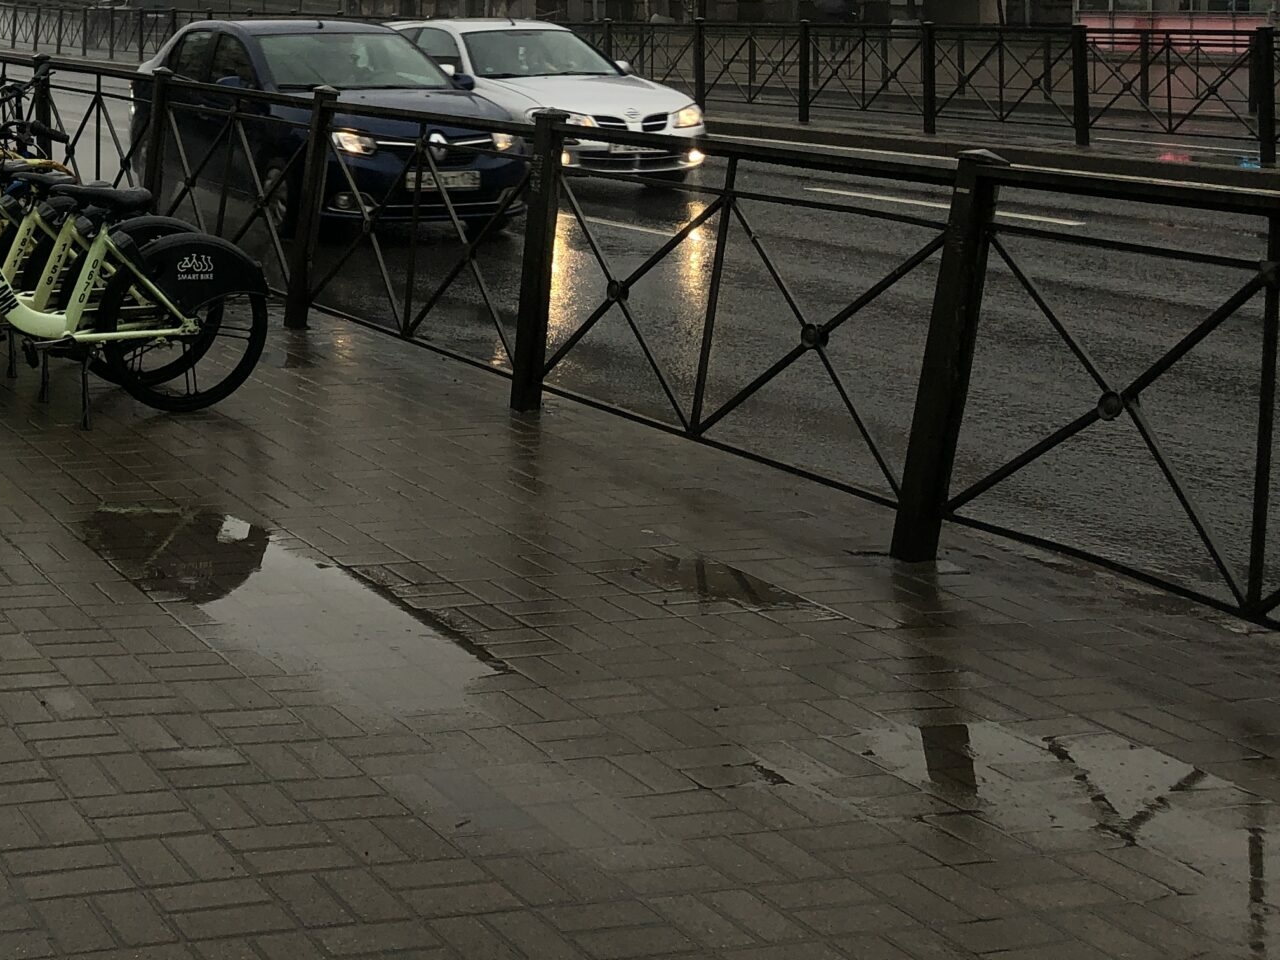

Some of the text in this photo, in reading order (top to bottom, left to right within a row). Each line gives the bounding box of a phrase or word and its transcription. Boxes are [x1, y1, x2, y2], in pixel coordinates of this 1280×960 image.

[13, 228, 33, 268] 1871
[46, 243, 68, 286] 1159
[78, 258, 100, 304] 0670
